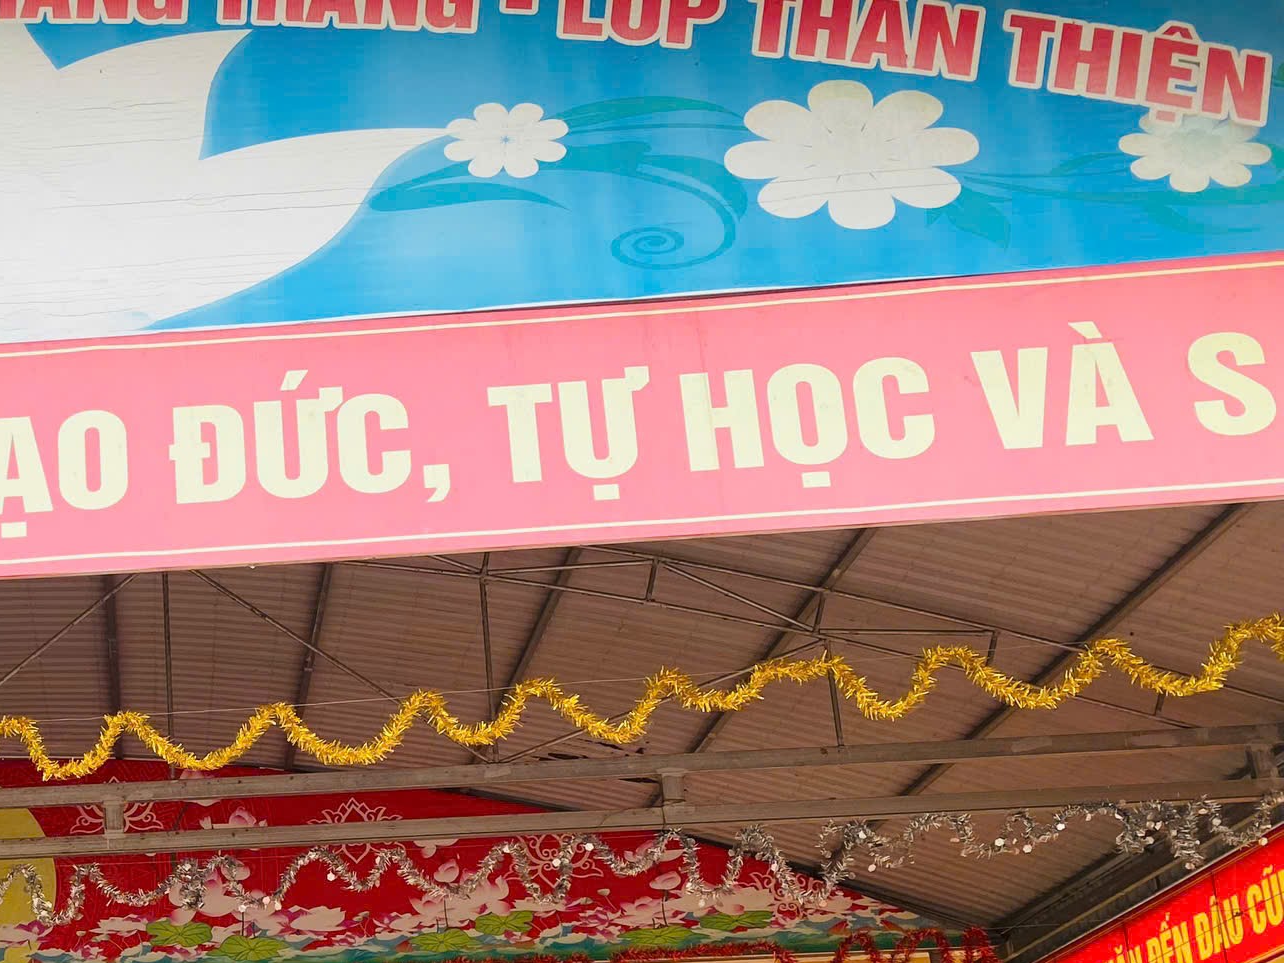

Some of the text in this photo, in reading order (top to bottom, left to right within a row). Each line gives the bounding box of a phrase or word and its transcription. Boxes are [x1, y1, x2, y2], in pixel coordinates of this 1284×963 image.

[1004, 18, 1272, 126] THIỆN
[169, 370, 450, 504] ĐỨC,
[487, 366, 650, 500] TỰ
[679, 357, 935, 488] HỌC
[971, 322, 1154, 449] VÀ
[1193, 895, 1244, 961] ĐÂU
